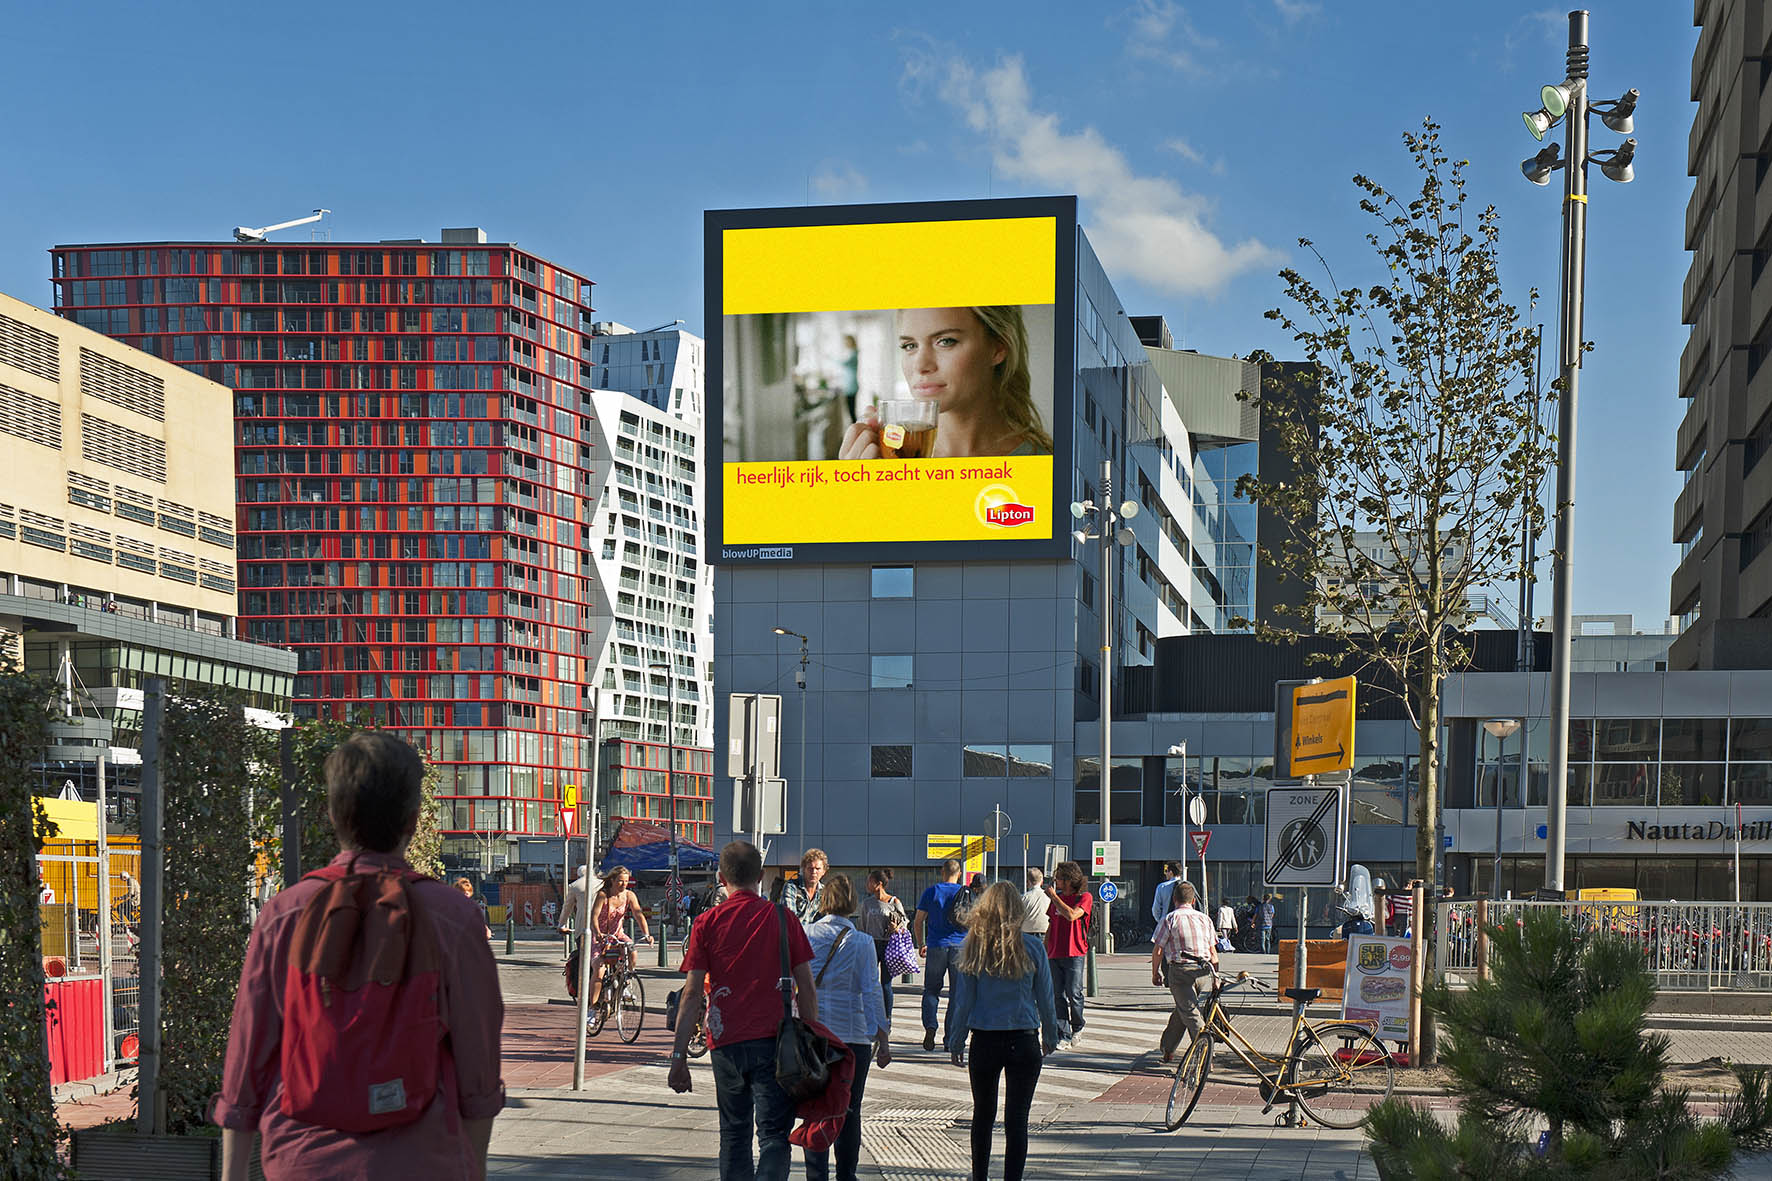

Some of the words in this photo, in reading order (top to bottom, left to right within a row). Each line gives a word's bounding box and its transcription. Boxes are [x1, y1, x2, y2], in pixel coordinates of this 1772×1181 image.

[737, 466, 795, 488] heerlijk
[800, 465, 828, 487] rijk,
[834, 464, 870, 483] toch
[876, 463, 920, 482] zacht
[926, 468, 954, 480] van
[960, 461, 1013, 479] smaak
[990, 508, 1031, 522] Lipton
[1289, 796, 1319, 805] ZONE
[1361, 945, 1385, 953] SUB
